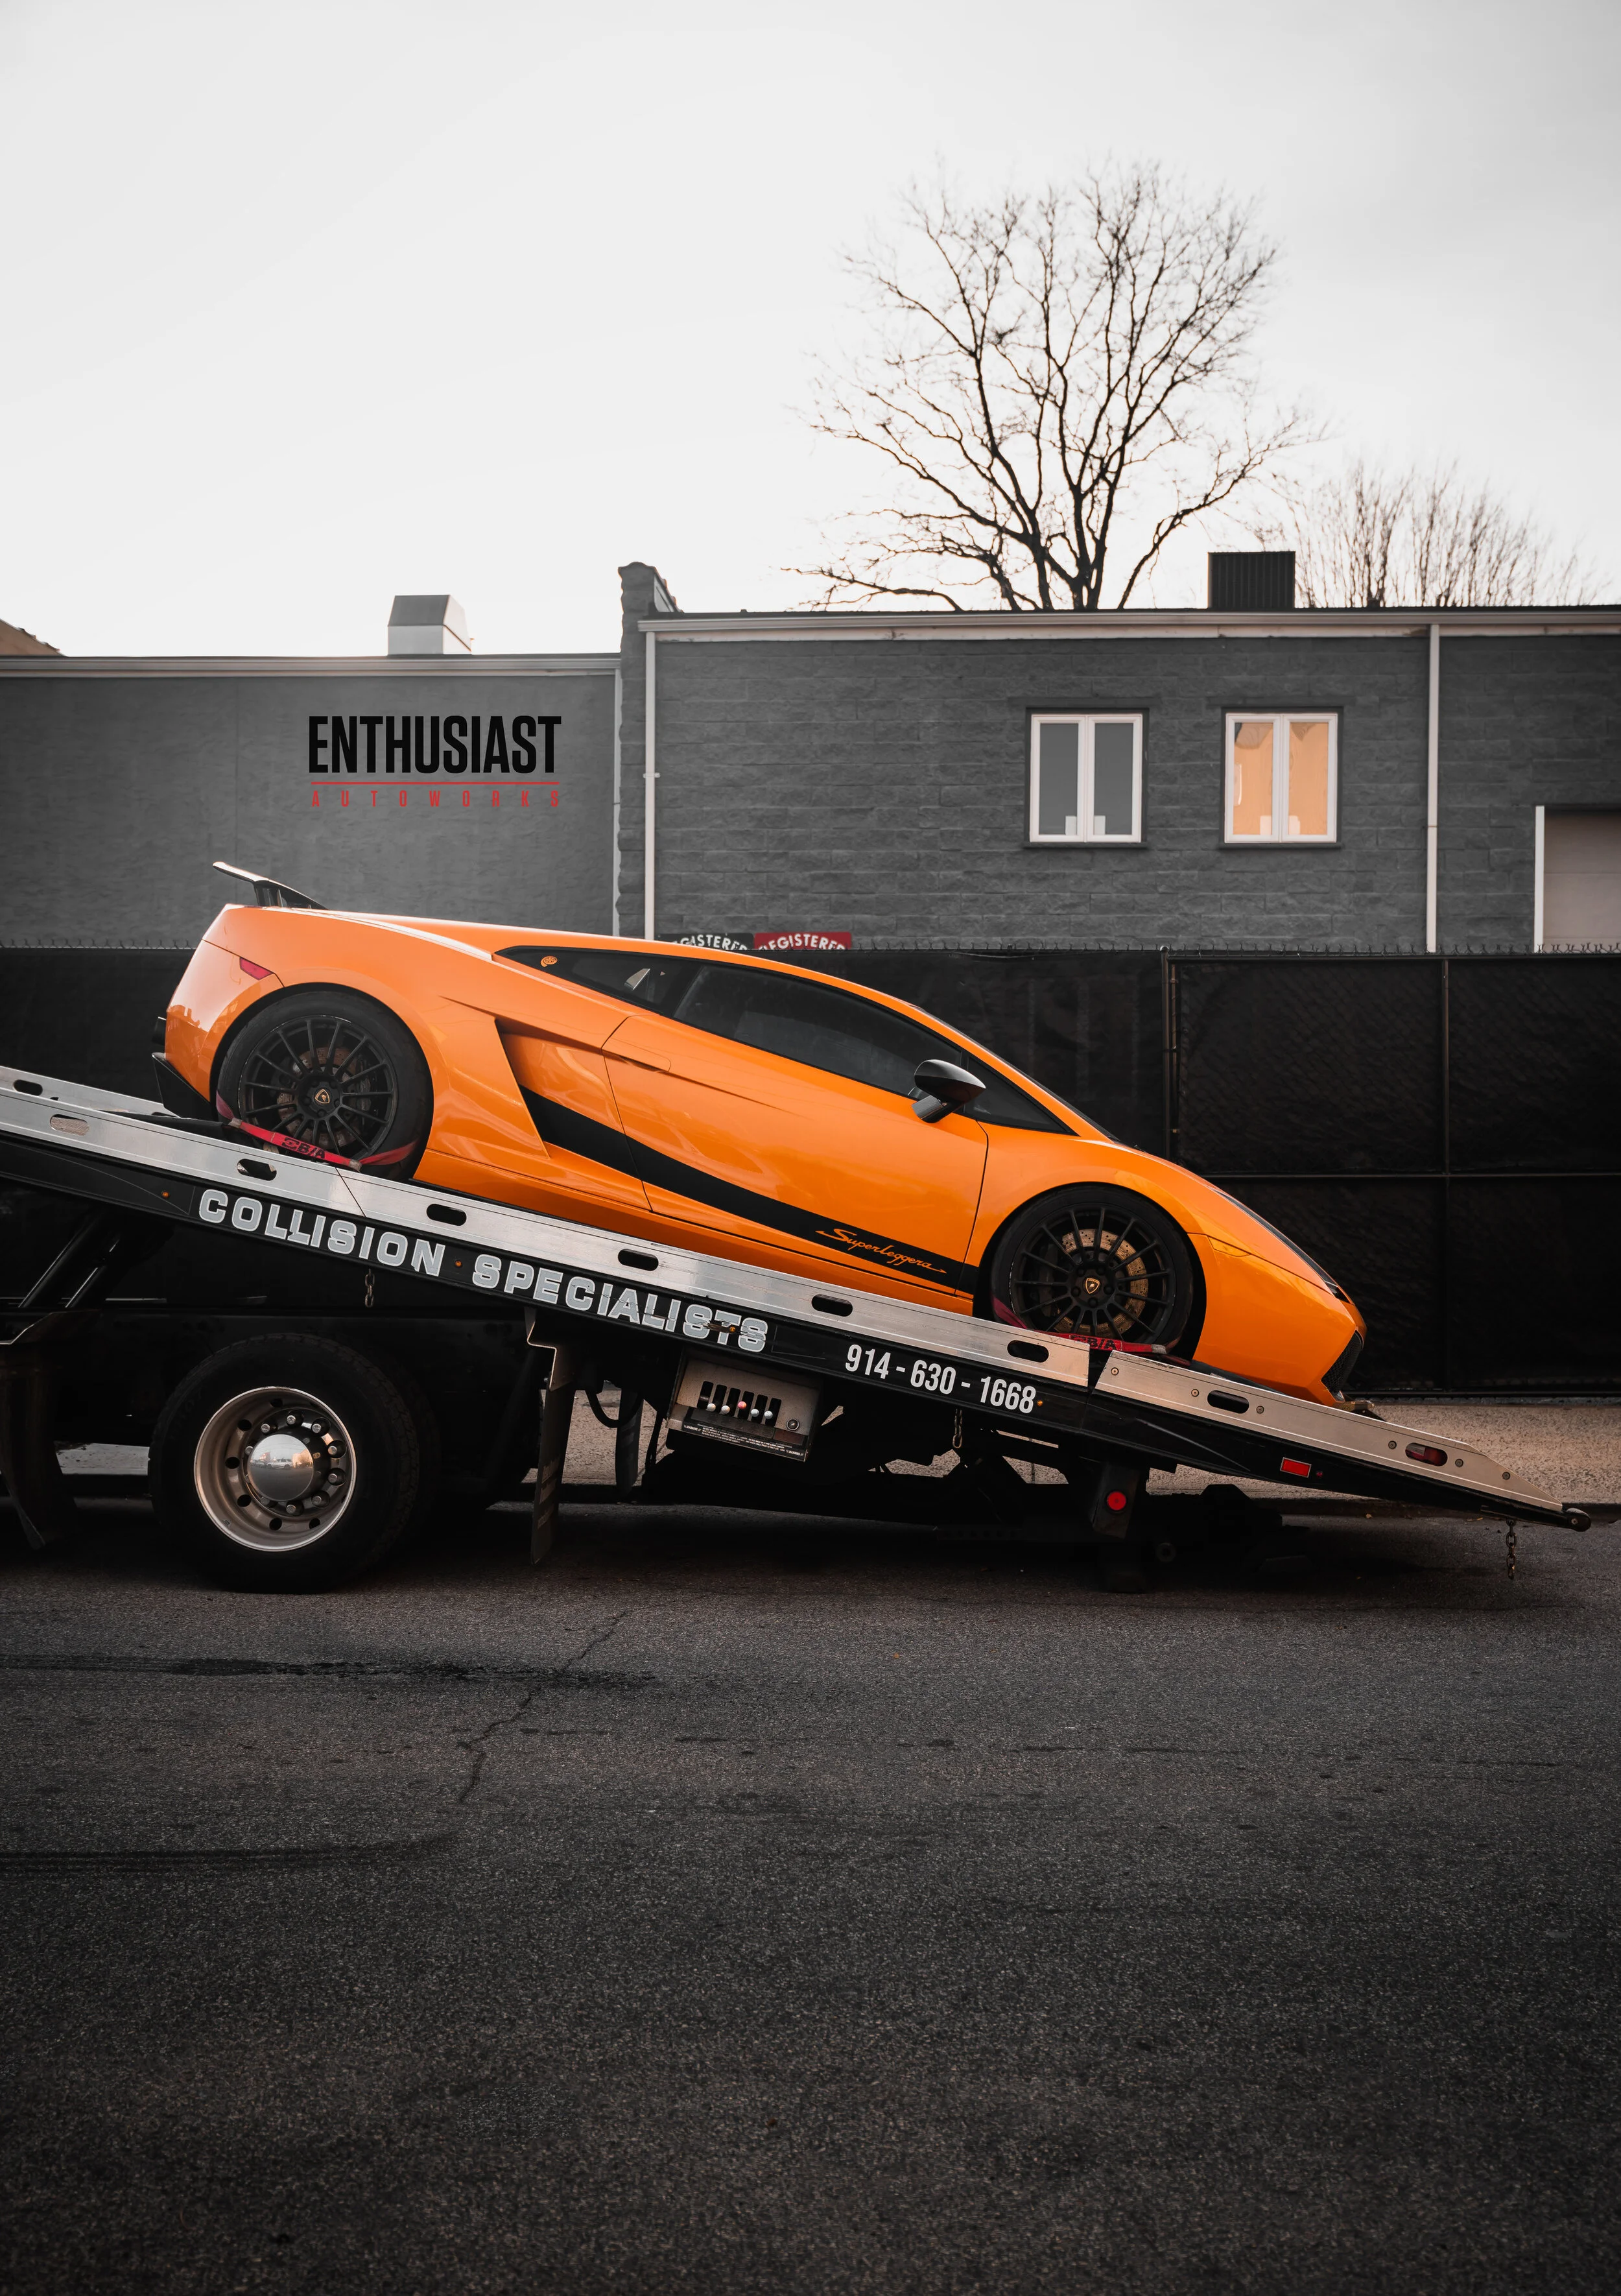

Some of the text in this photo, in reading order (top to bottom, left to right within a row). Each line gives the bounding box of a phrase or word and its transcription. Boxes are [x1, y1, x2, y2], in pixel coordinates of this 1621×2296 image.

[309, 715, 562, 774] ENTHUSIAST
[311, 790, 559, 807] AUTOWORKS
[199, 1189, 768, 1352] COLLISION SPECIALISTS
[815, 1228, 947, 1274] Superleggera
